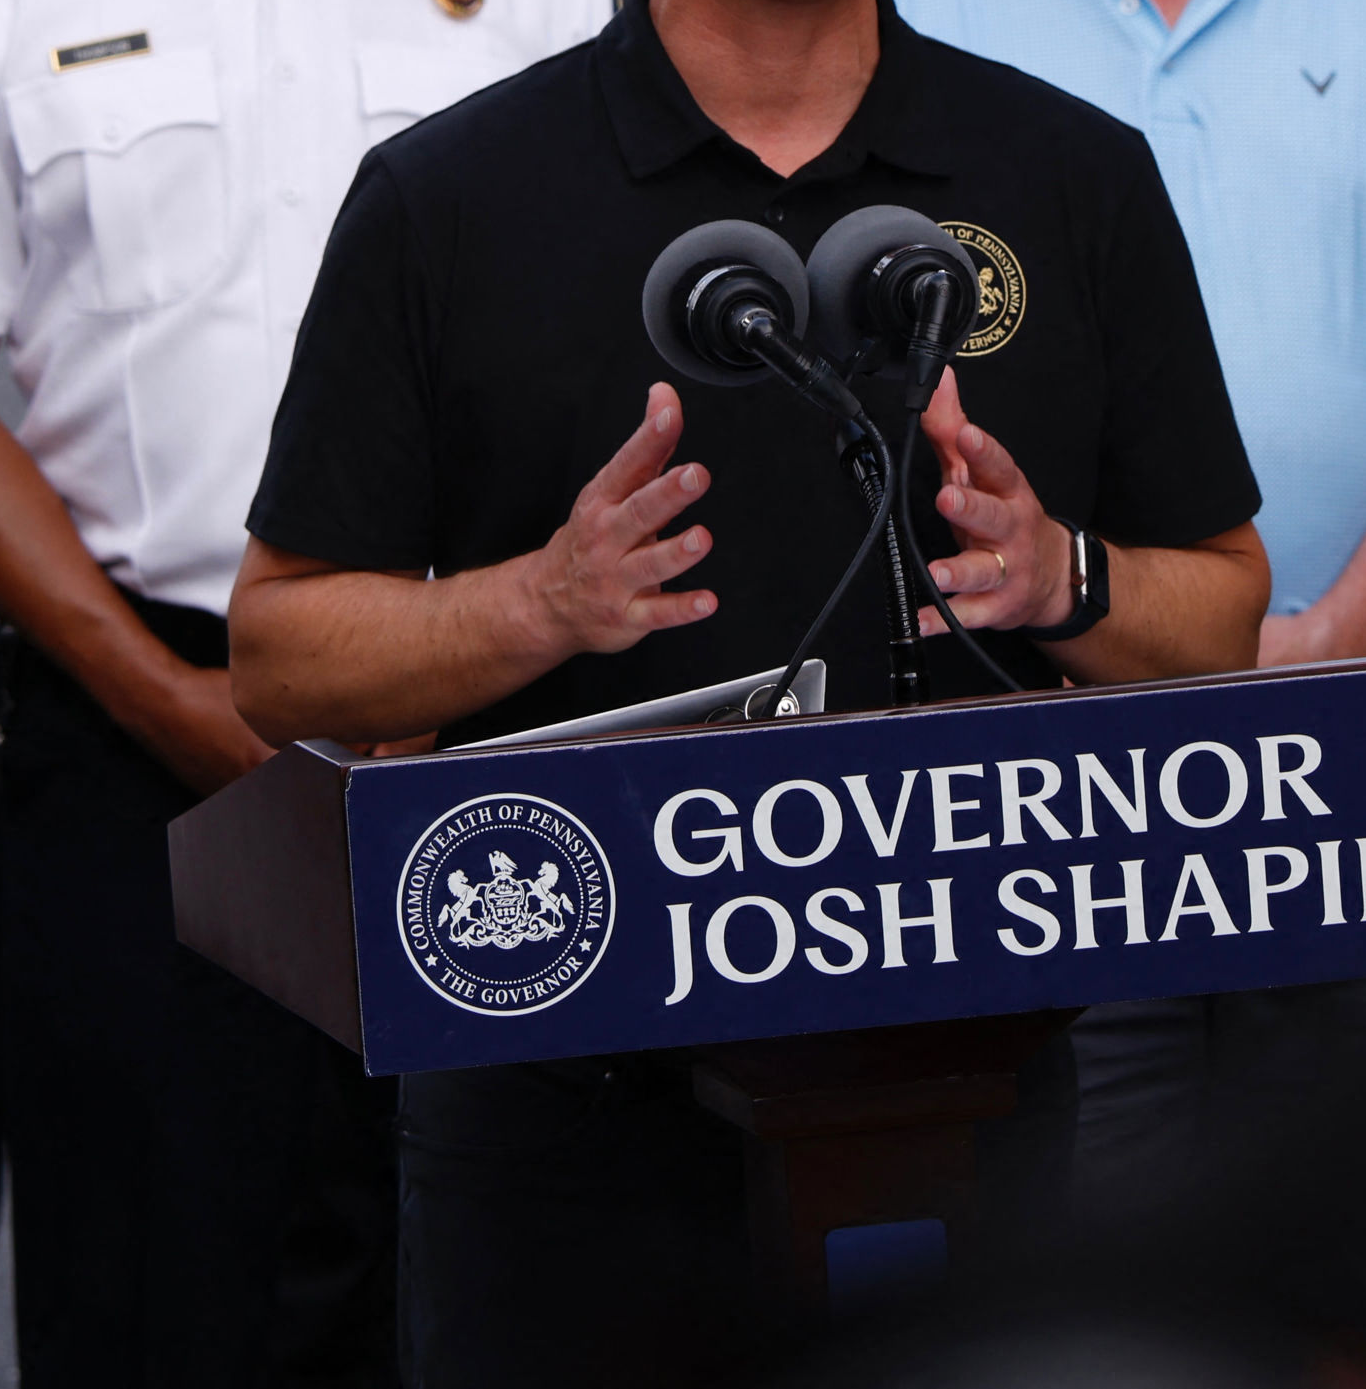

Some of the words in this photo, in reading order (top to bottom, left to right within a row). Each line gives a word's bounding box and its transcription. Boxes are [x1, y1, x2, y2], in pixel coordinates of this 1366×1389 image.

[957, 228, 974, 240] OF
[975, 233, 1021, 314] PENNSYLVANIA
[653, 734, 1333, 877] GOVERNOR
[407, 806, 493, 950] COMMONWEALTH
[498, 804, 524, 821] OF
[527, 808, 603, 930] PENNSYLVANIA
[664, 877, 959, 1006] JOSH
[439, 966, 477, 999] THE
[481, 955, 583, 1004] GOVERNOR
